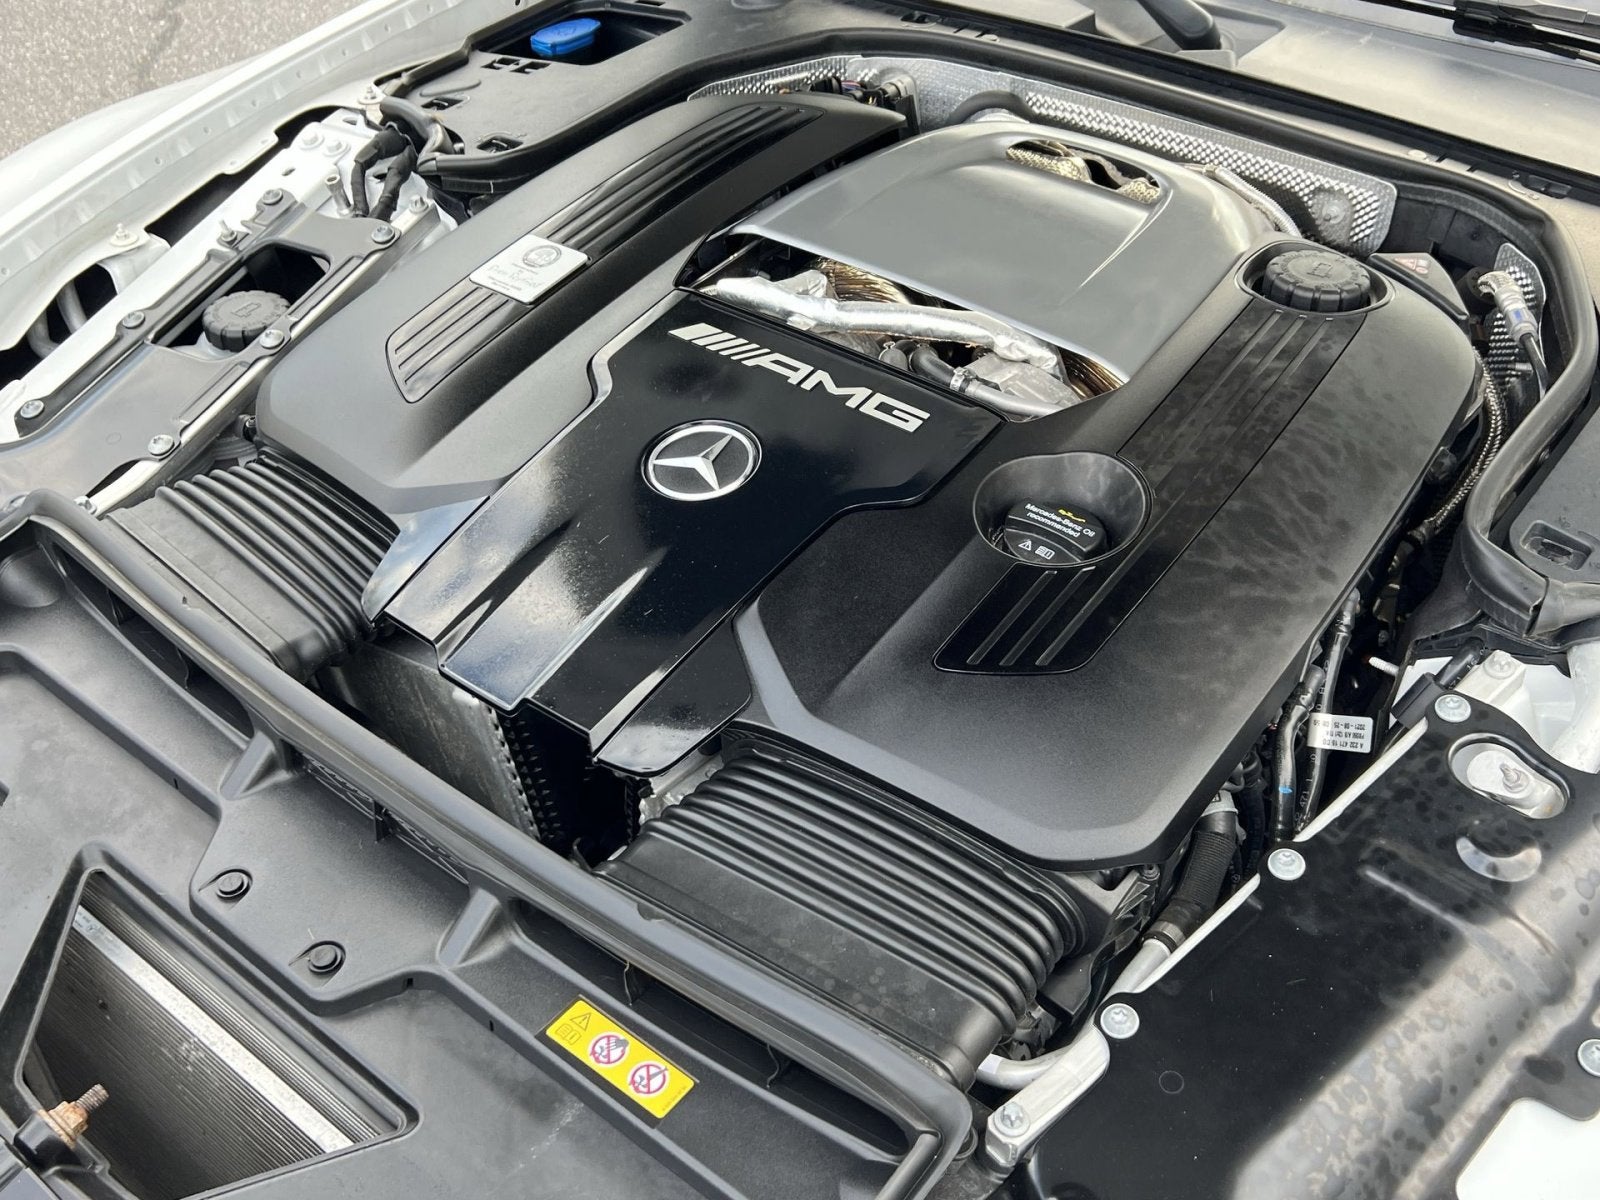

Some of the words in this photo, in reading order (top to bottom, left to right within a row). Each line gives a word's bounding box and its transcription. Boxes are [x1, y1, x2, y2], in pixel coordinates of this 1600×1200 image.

[740, 351, 931, 433] AMG
[1025, 503, 1083, 532] Mercedes-Benz
[1082, 528, 1096, 537] Oil
[1026, 512, 1081, 538] recommended
